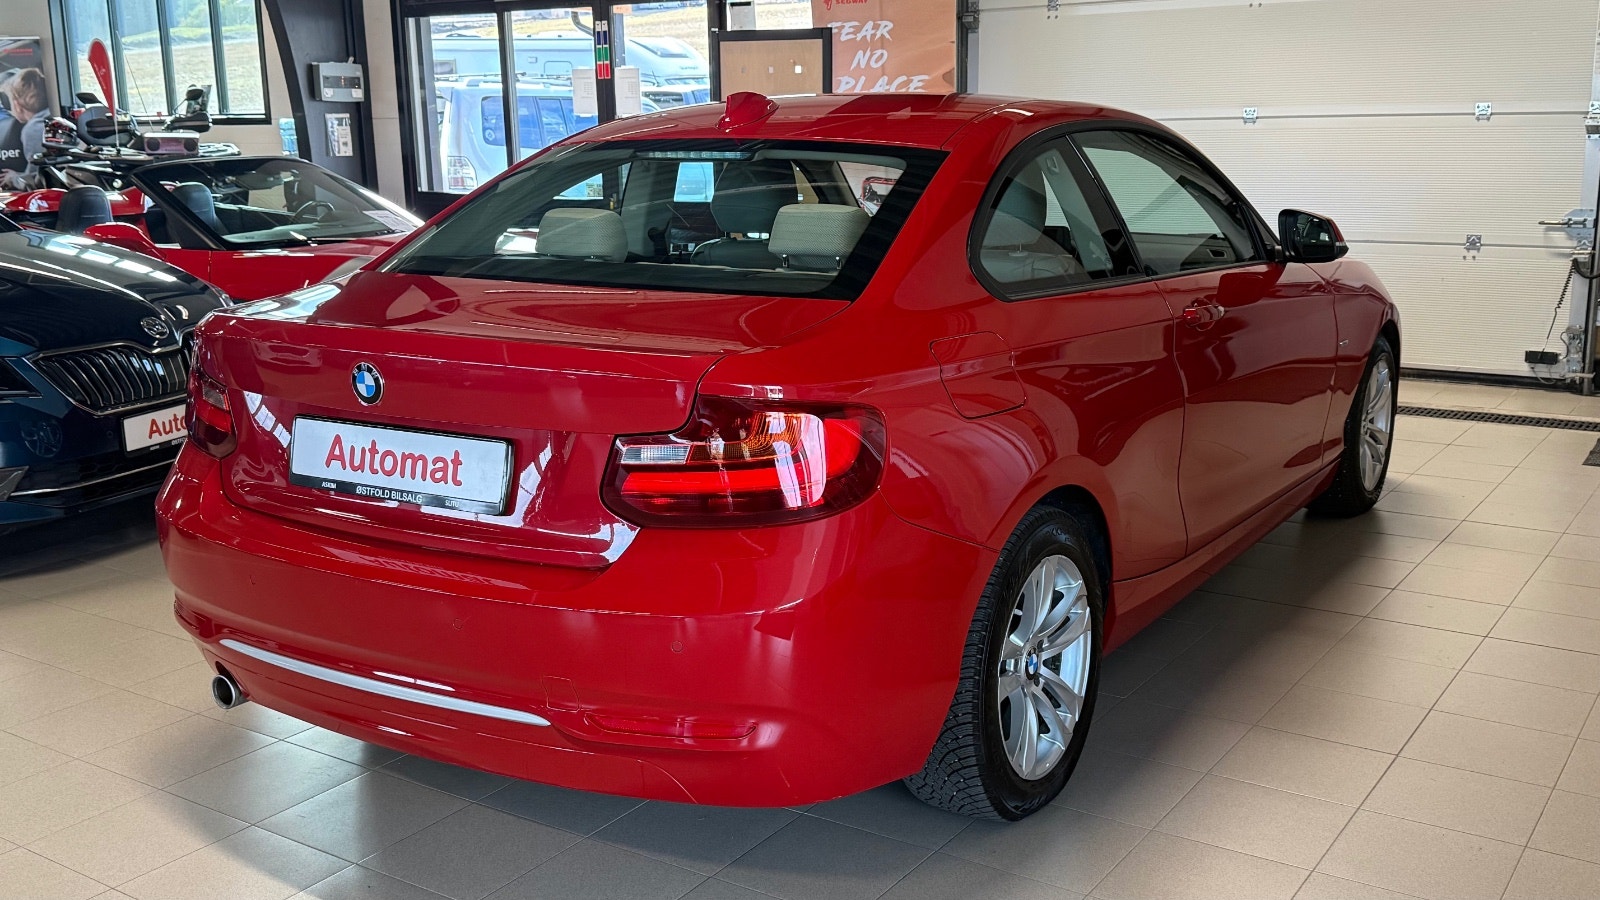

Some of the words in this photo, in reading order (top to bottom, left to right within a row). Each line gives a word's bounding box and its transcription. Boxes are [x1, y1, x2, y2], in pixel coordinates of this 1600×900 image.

[828, 20, 893, 42] FEAR
[850, 47, 888, 71] NO
[836, 74, 931, 93] PLACE
[325, 433, 463, 487] Automat
[355, 485, 390, 499] ØSTFOLD
[391, 490, 423, 504] BILSALG
